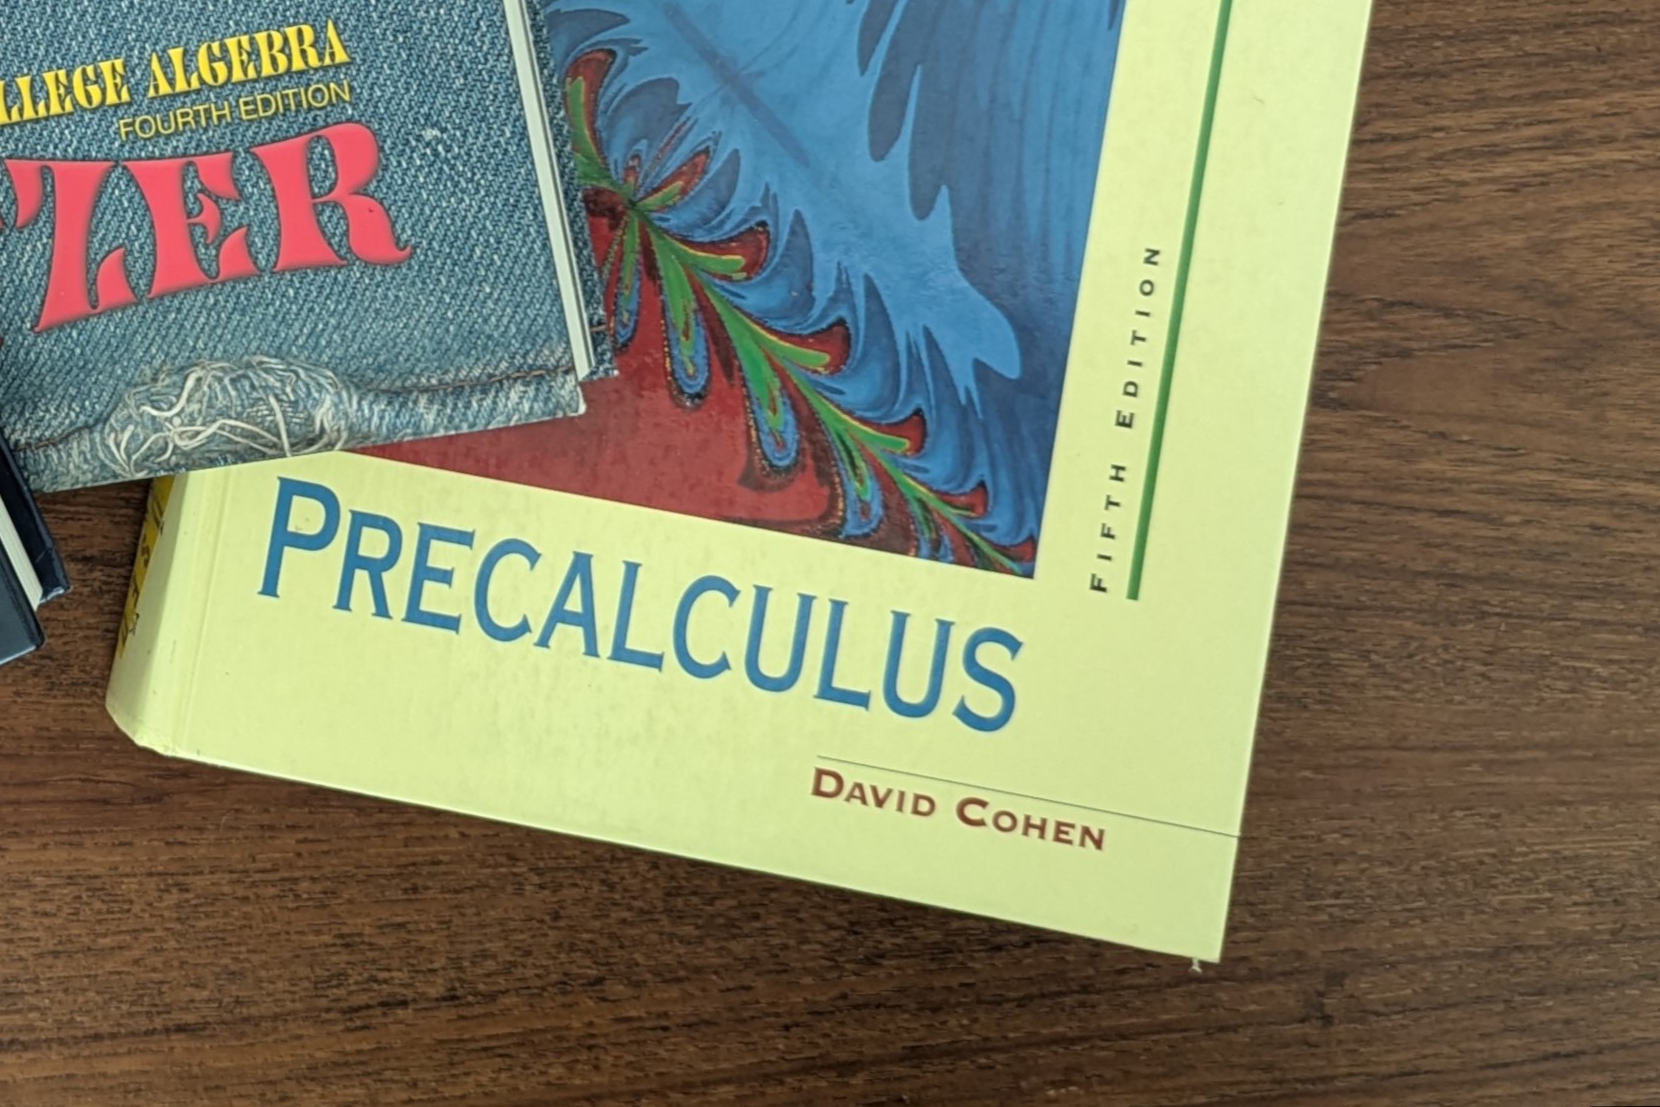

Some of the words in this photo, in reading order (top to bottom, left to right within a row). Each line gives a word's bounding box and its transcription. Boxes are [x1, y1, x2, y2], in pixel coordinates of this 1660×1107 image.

[146, 19, 352, 98] ALGEBRA
[119, 100, 233, 141] FOURTH
[239, 79, 353, 121] EDITION
[1089, 462, 1127, 593] FIFTH
[1115, 246, 1161, 429] EDITION
[257, 476, 1024, 733] PRECALCULUS
[810, 766, 937, 818] DAVID
[954, 795, 1105, 851] COHEN
